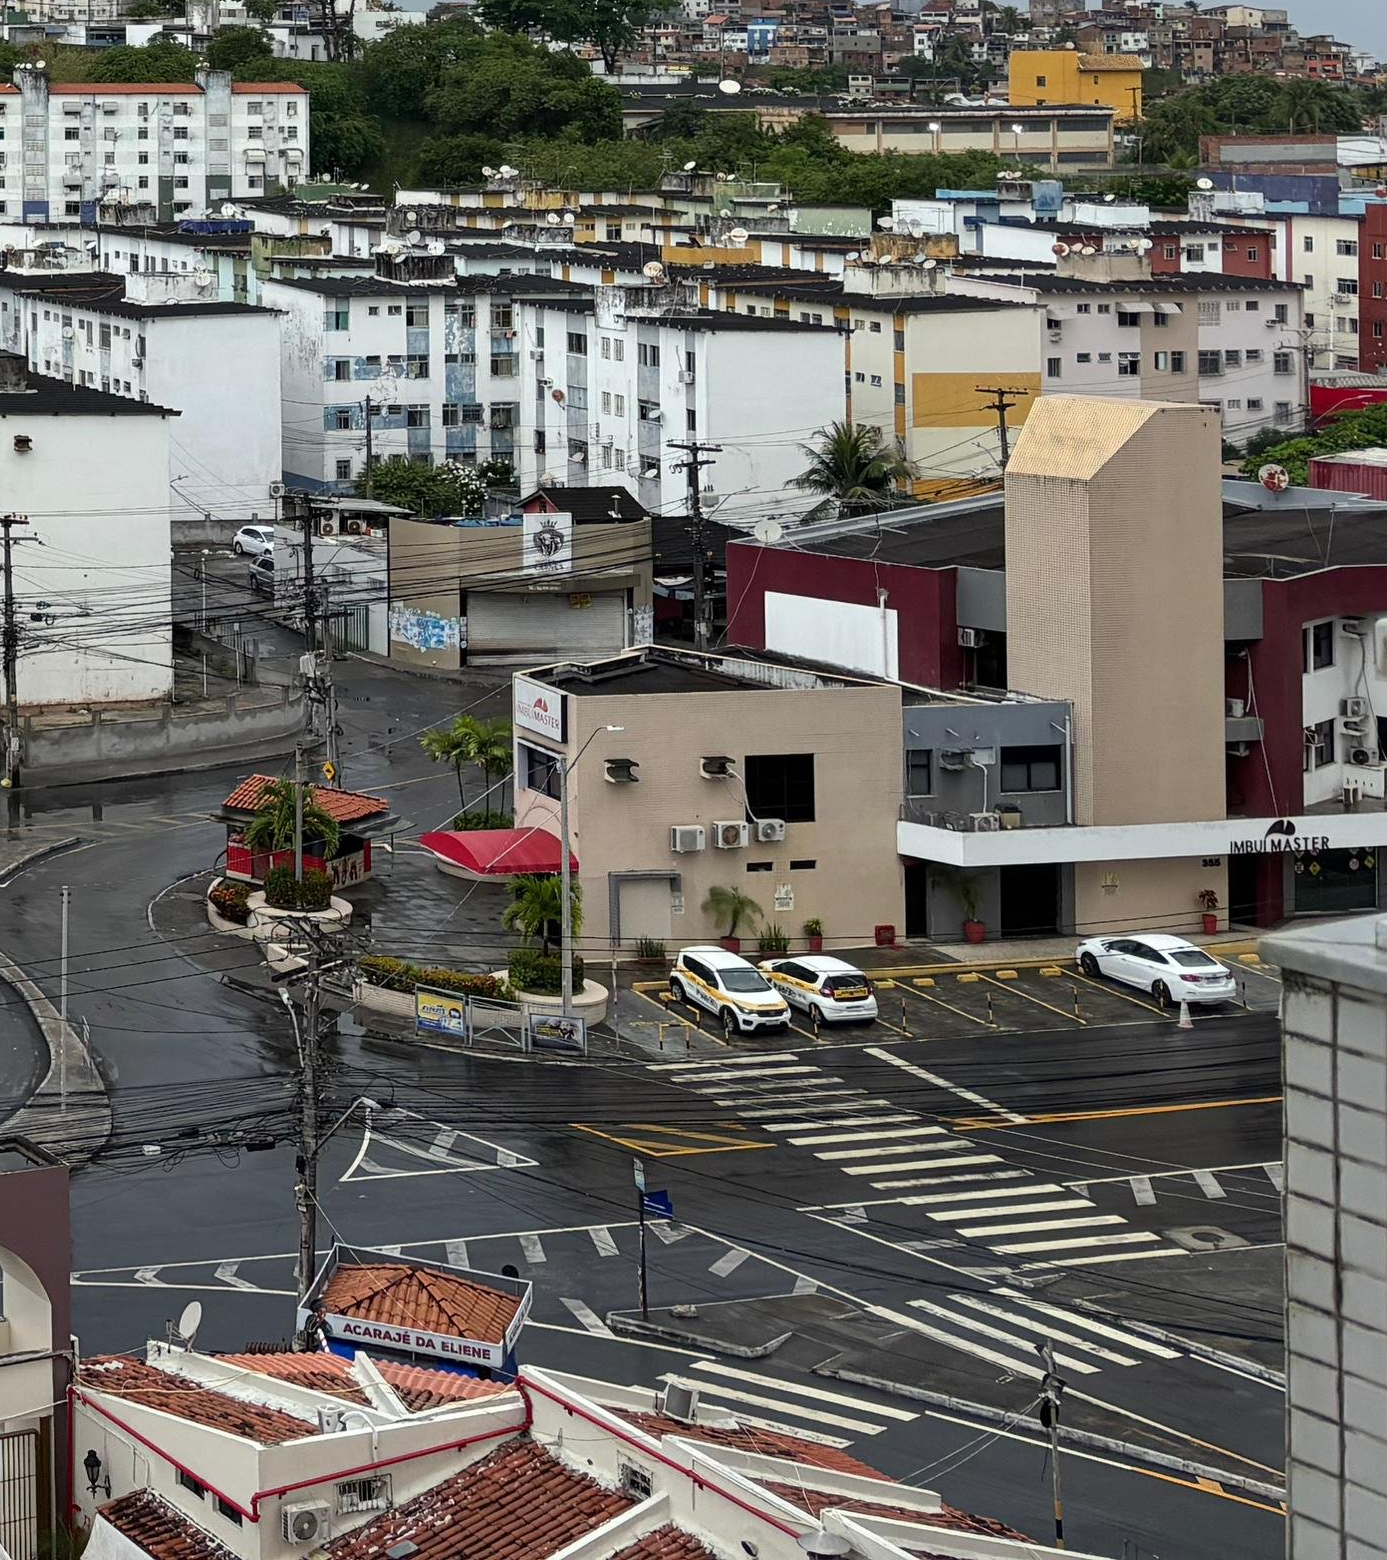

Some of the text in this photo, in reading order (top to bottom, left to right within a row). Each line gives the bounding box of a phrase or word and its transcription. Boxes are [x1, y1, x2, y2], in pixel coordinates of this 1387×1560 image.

[534, 711, 560, 729] MASTER
[1271, 835, 1330, 852] MASTER
[343, 1323, 491, 1360] ACARAJÉ DA ELIENE
